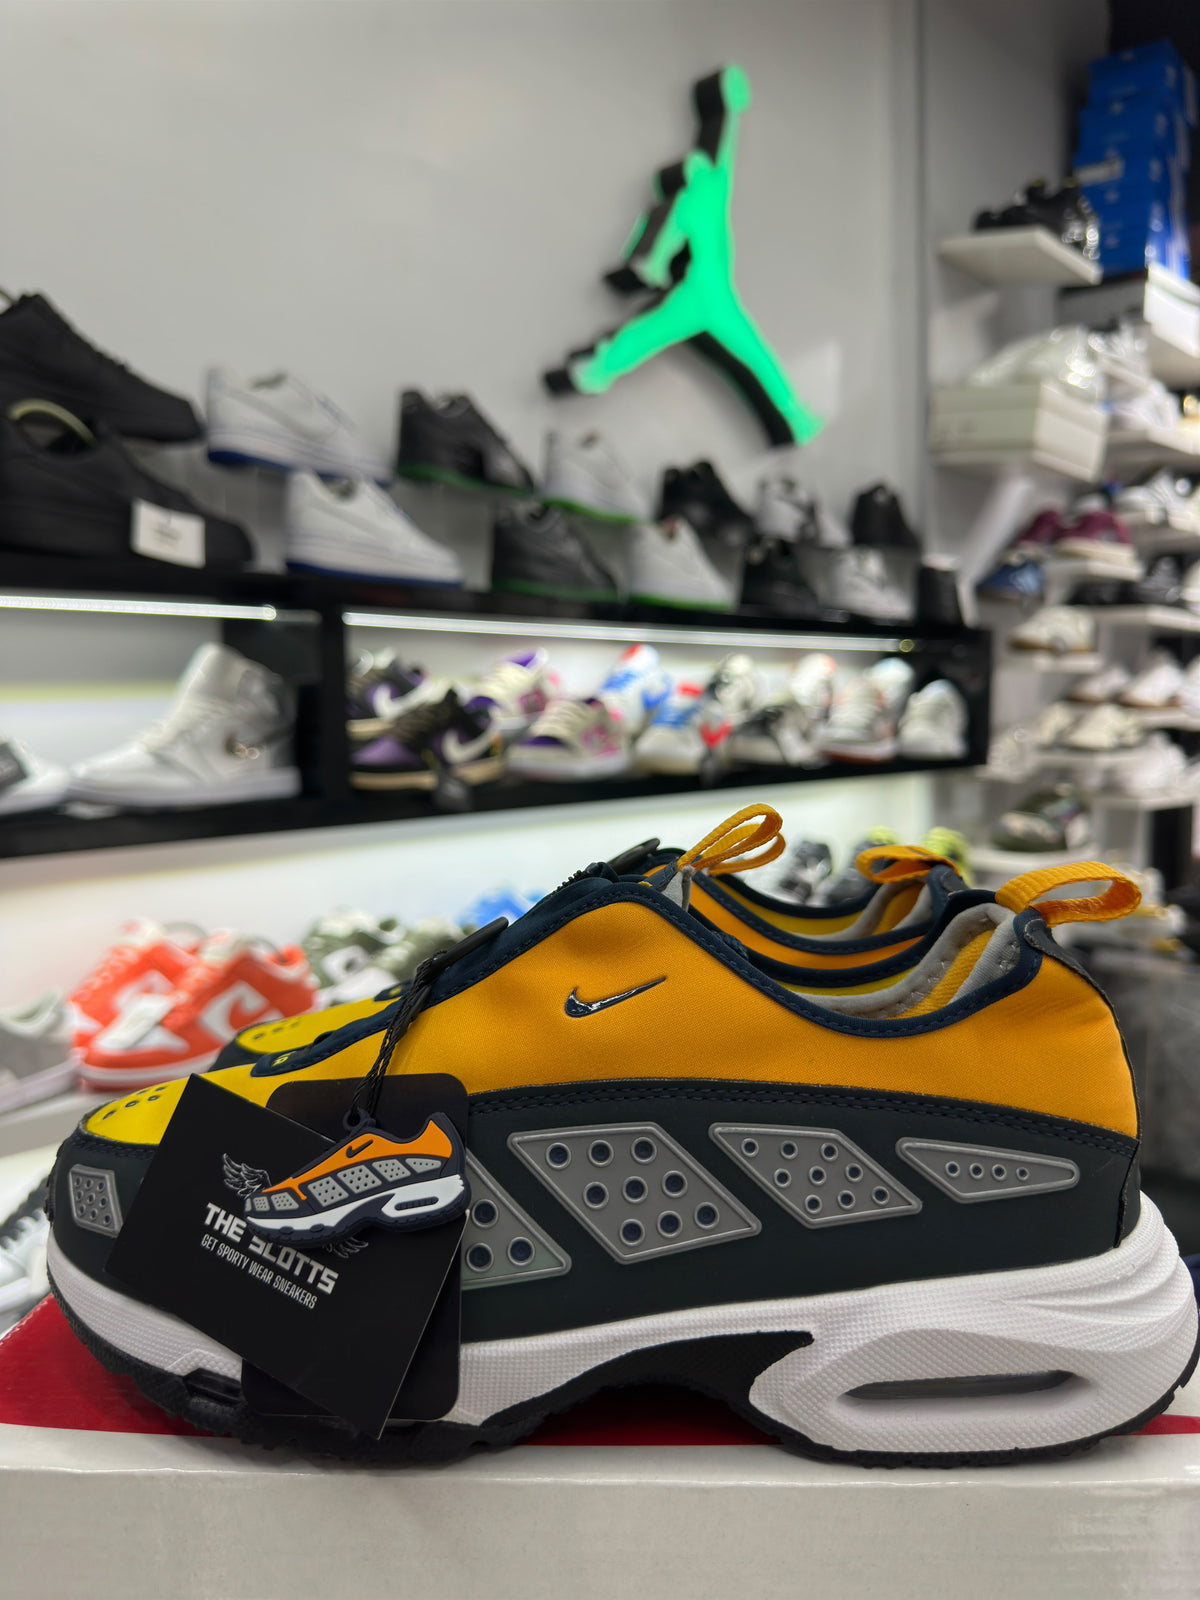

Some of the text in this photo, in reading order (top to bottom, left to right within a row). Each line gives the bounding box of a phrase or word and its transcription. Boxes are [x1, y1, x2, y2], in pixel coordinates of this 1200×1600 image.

[204, 1202, 247, 1242] THE
[201, 1233, 318, 1309] GET SPORTY WEAR SNEAKERS
